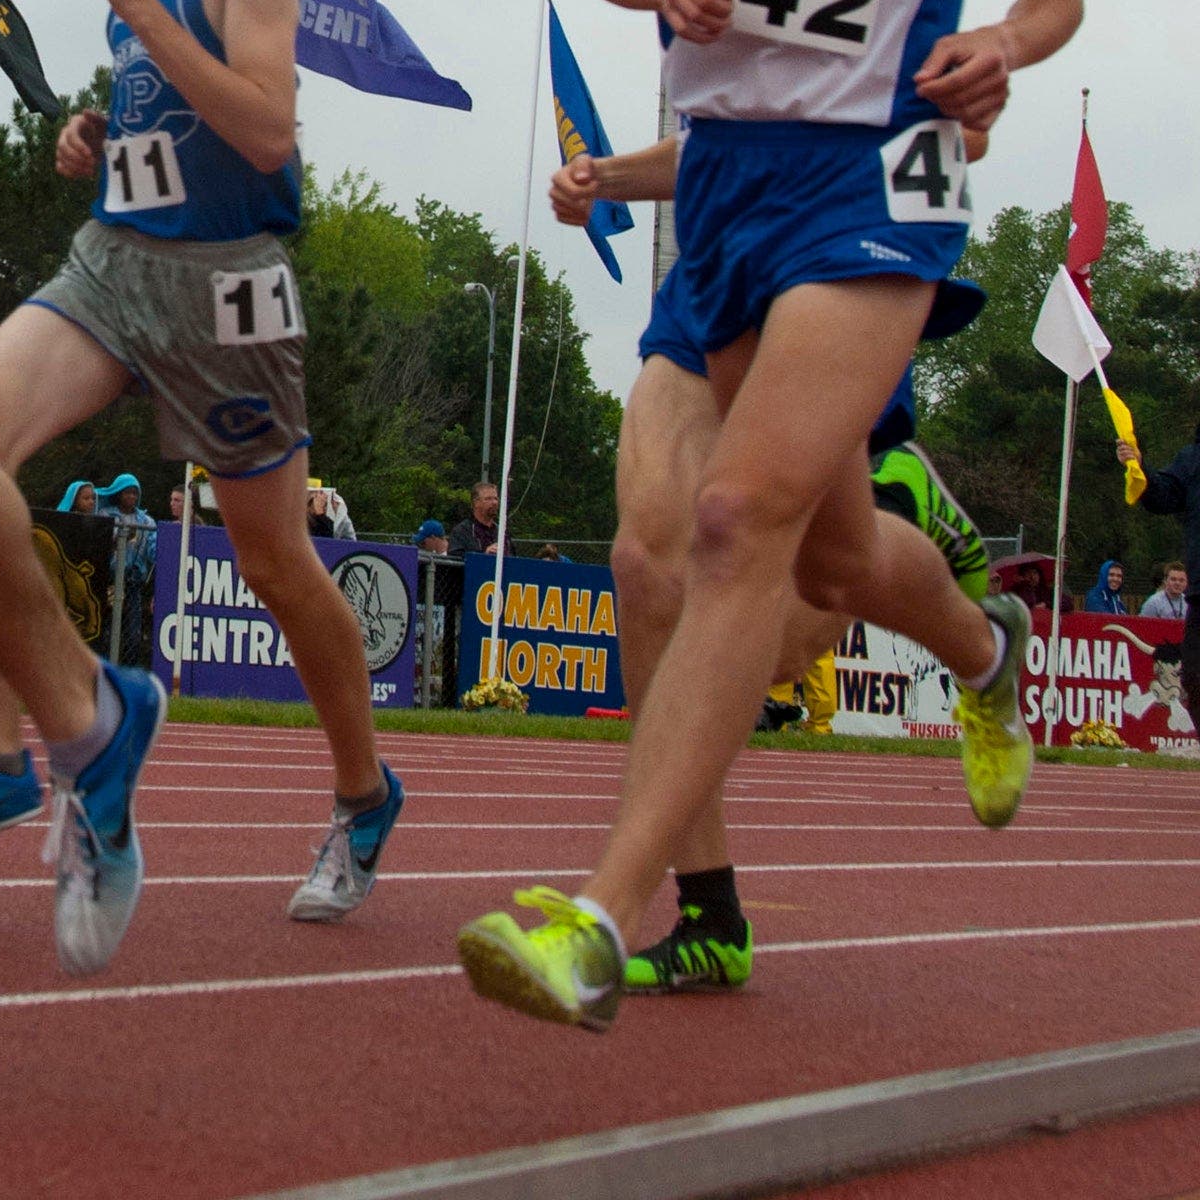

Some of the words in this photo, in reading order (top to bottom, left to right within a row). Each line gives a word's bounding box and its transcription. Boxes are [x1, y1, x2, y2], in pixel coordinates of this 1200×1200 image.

[112, 139, 170, 202] 11
[224, 270, 294, 336] 11
[476, 580, 617, 637] OMAHA
[159, 612, 296, 667] CENTRA
[479, 637, 607, 693] NORTH
[1025, 635, 1132, 681] OMAHA
[1024, 684, 1122, 728] SOUTH
